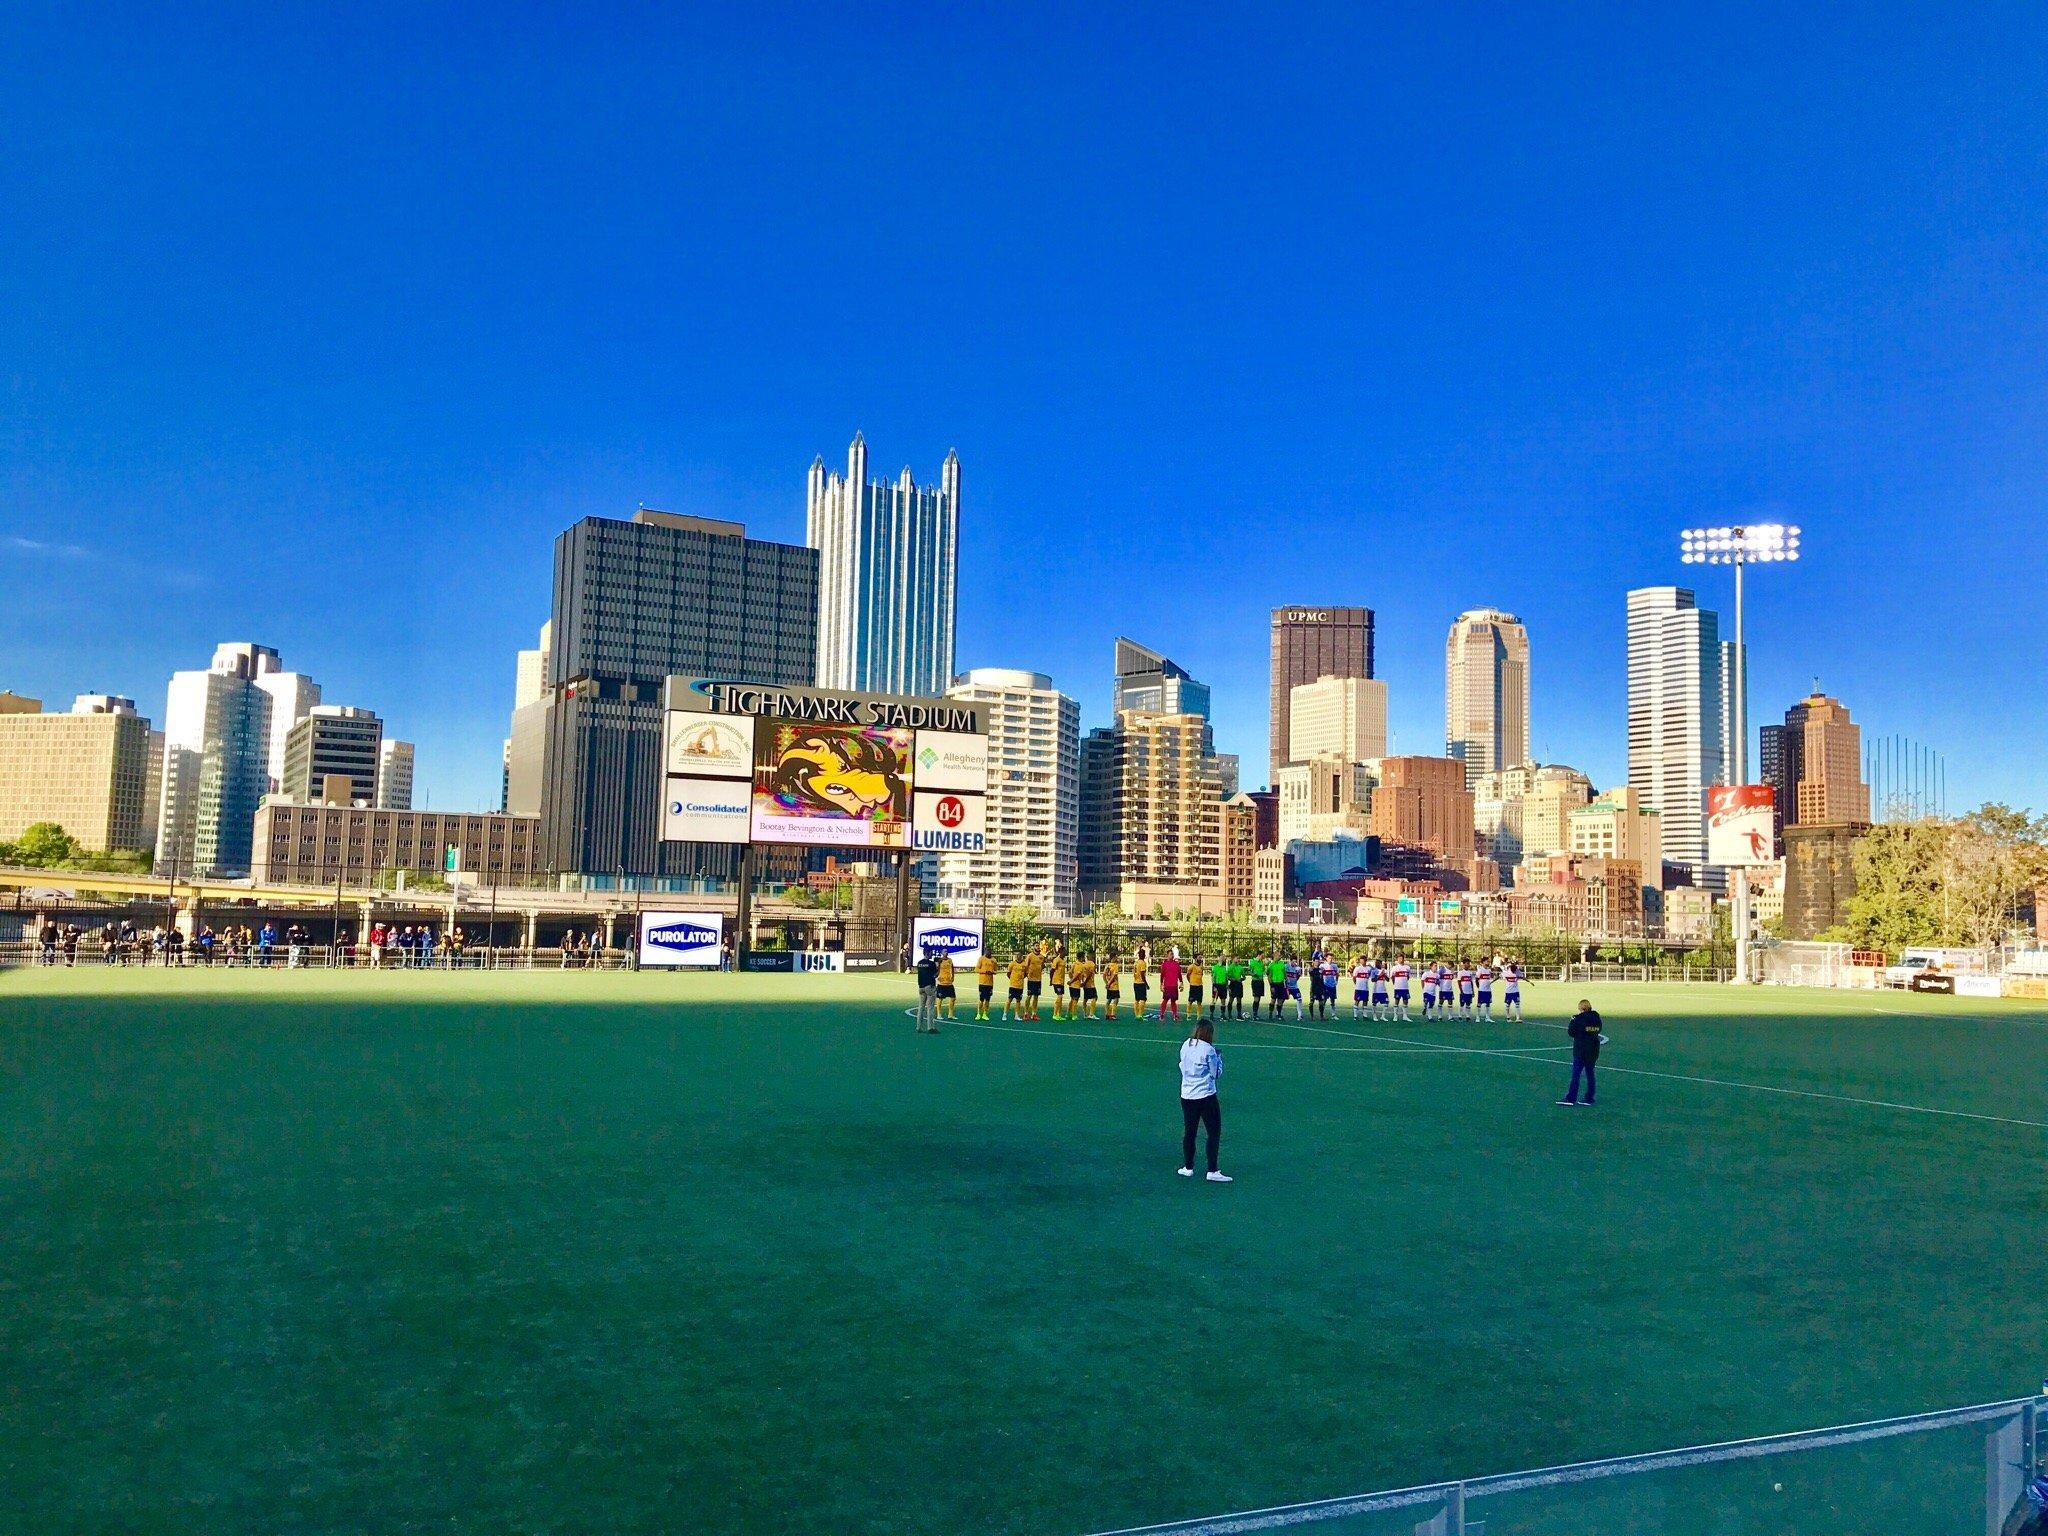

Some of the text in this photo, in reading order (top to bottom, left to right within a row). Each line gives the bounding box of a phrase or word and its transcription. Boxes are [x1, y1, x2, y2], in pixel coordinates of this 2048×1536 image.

[1288, 612, 1327, 622] UPMC
[708, 684, 971, 731] HIGHMARK STADIUM
[943, 753, 986, 764] Allegheny
[686, 803, 748, 813] Consolidated
[939, 802, 961, 822] 84
[759, 822, 864, 834] Bootay Bevington & Nichols
[873, 822, 902, 834] STARTING
[914, 830, 984, 850] LUMBER
[650, 931, 716, 943] PUROLATOR
[921, 935, 977, 947] PUROLATOR
[801, 954, 837, 971] USL
